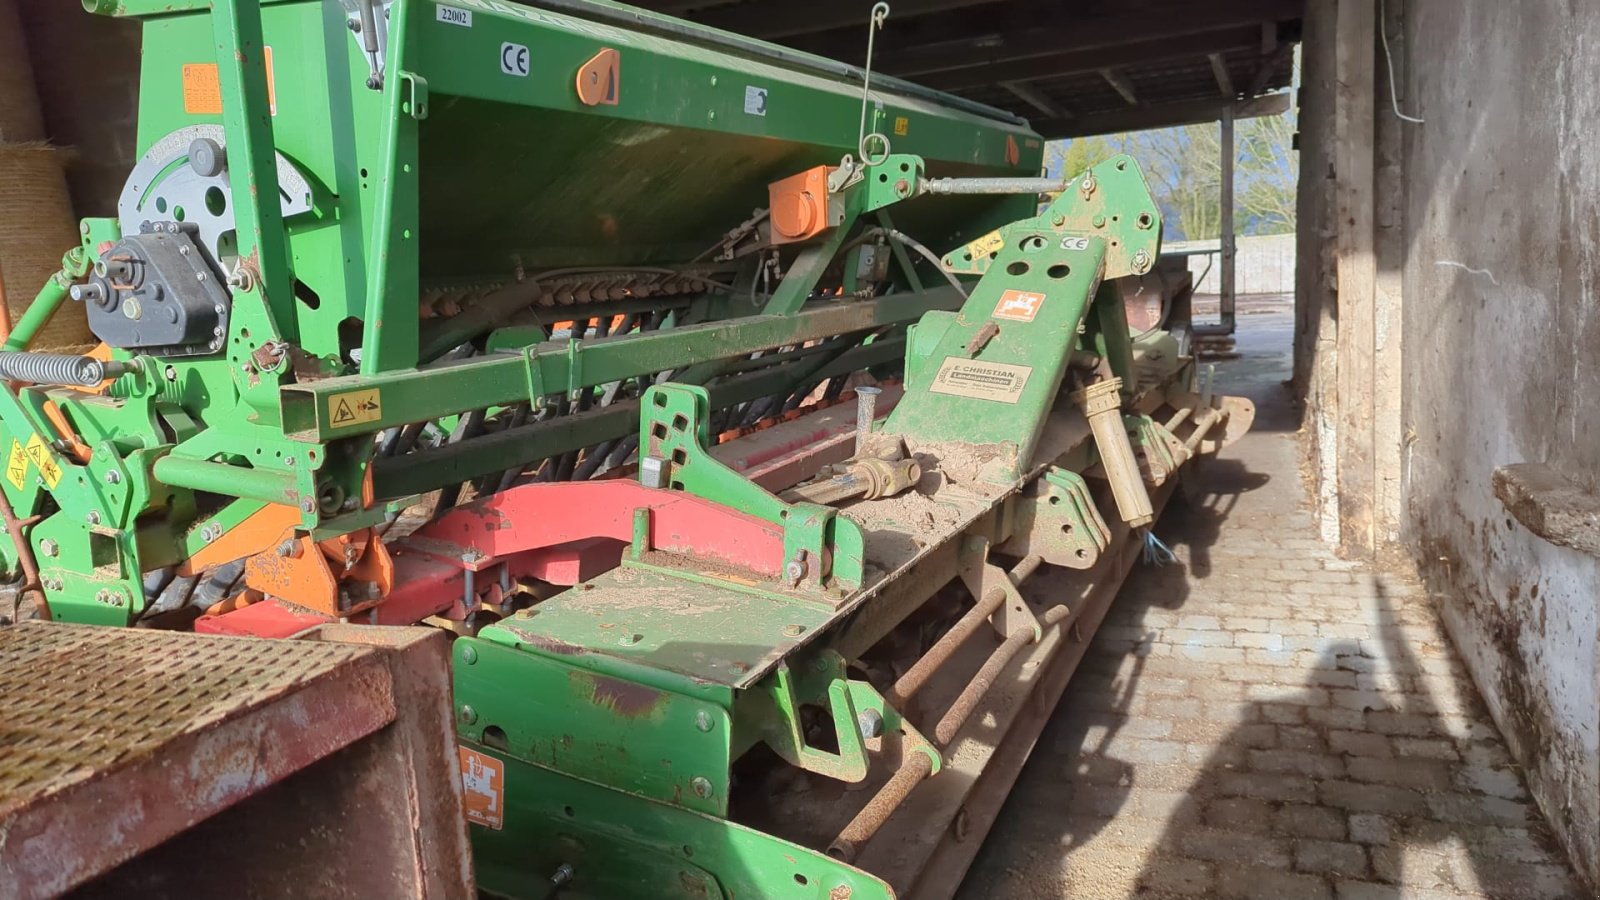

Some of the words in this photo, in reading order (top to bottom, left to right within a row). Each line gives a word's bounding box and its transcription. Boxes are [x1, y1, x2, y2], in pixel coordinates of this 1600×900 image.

[442, 8, 467, 24] 22002
[503, 45, 527, 75] CE
[1063, 238, 1088, 249] CE
[962, 366, 1016, 378] CHRISTIAN
